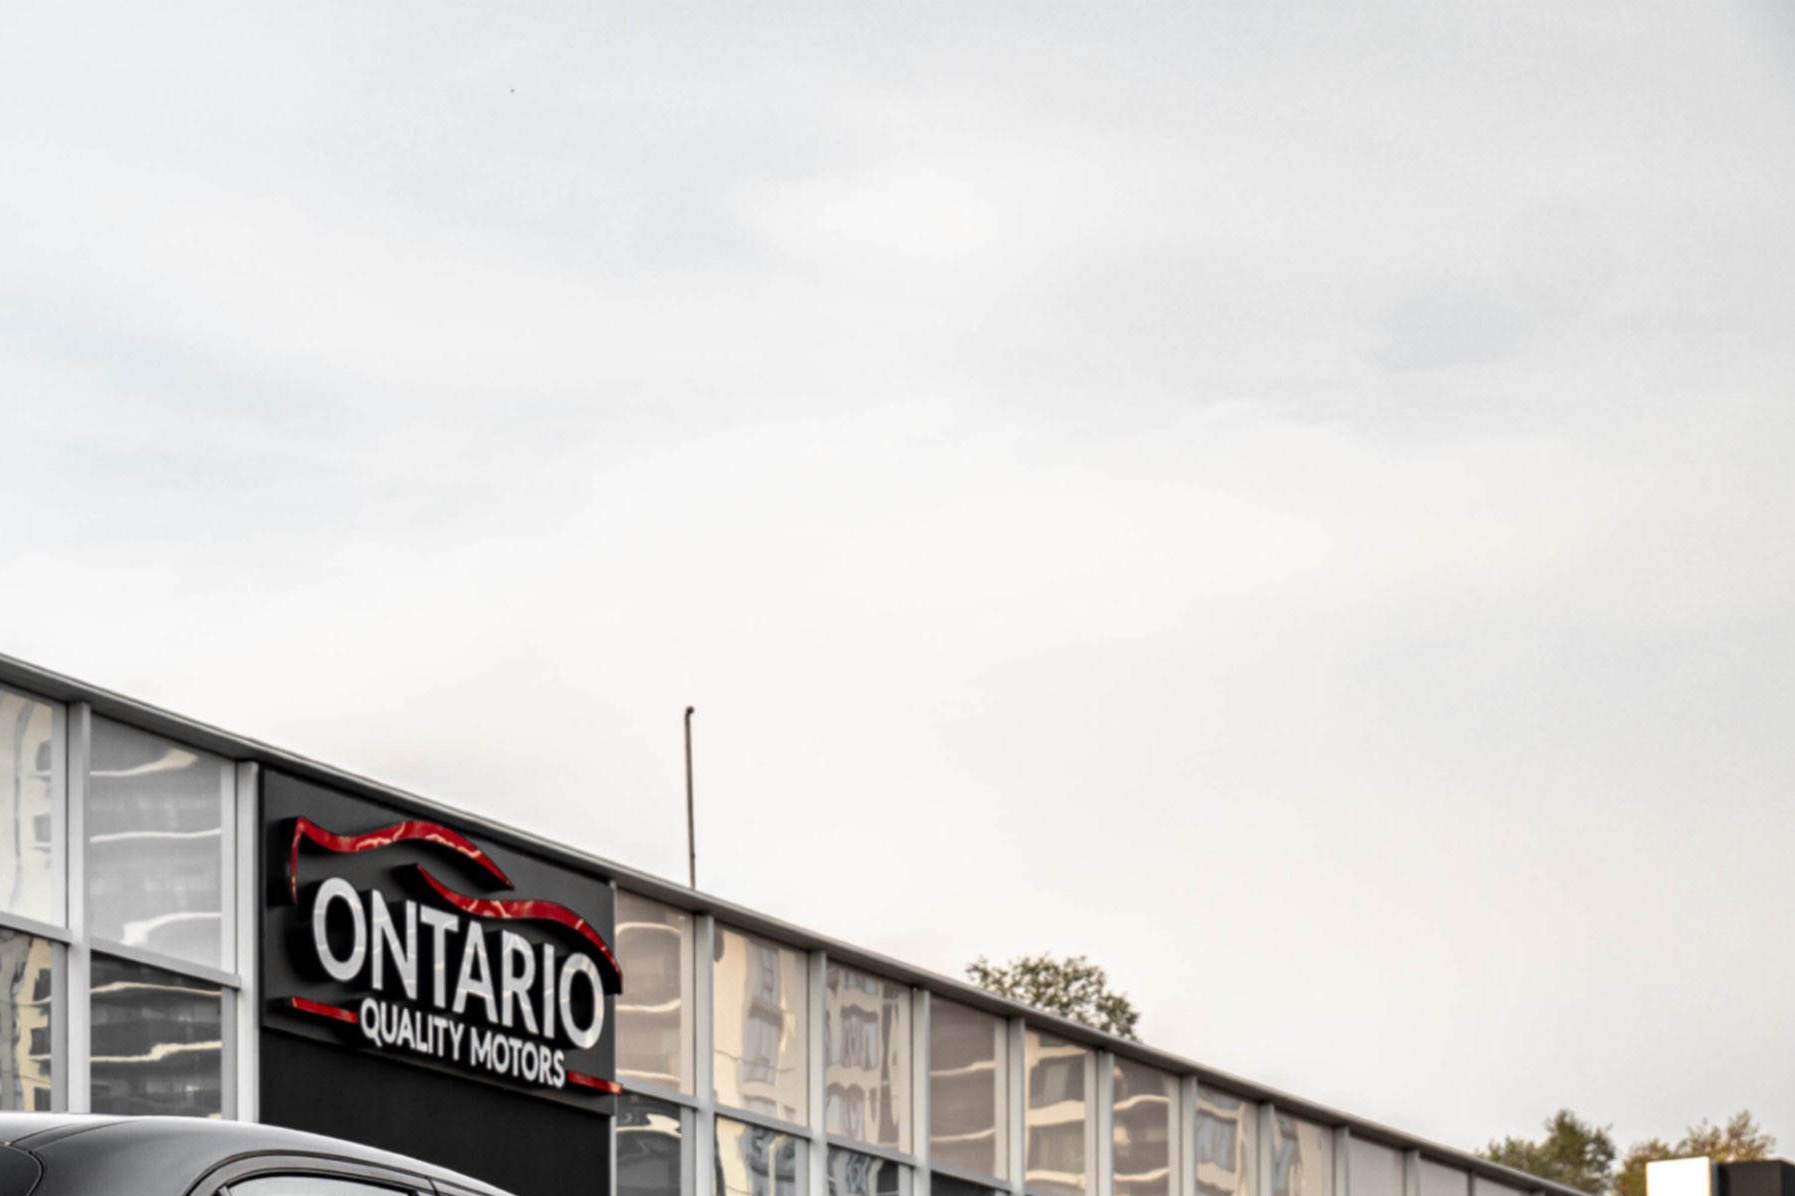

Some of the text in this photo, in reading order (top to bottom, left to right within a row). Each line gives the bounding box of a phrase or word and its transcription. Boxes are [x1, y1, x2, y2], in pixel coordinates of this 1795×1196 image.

[312, 877, 605, 1050] ONTARIO
[360, 997, 566, 1089] QUALITY MOTORS
